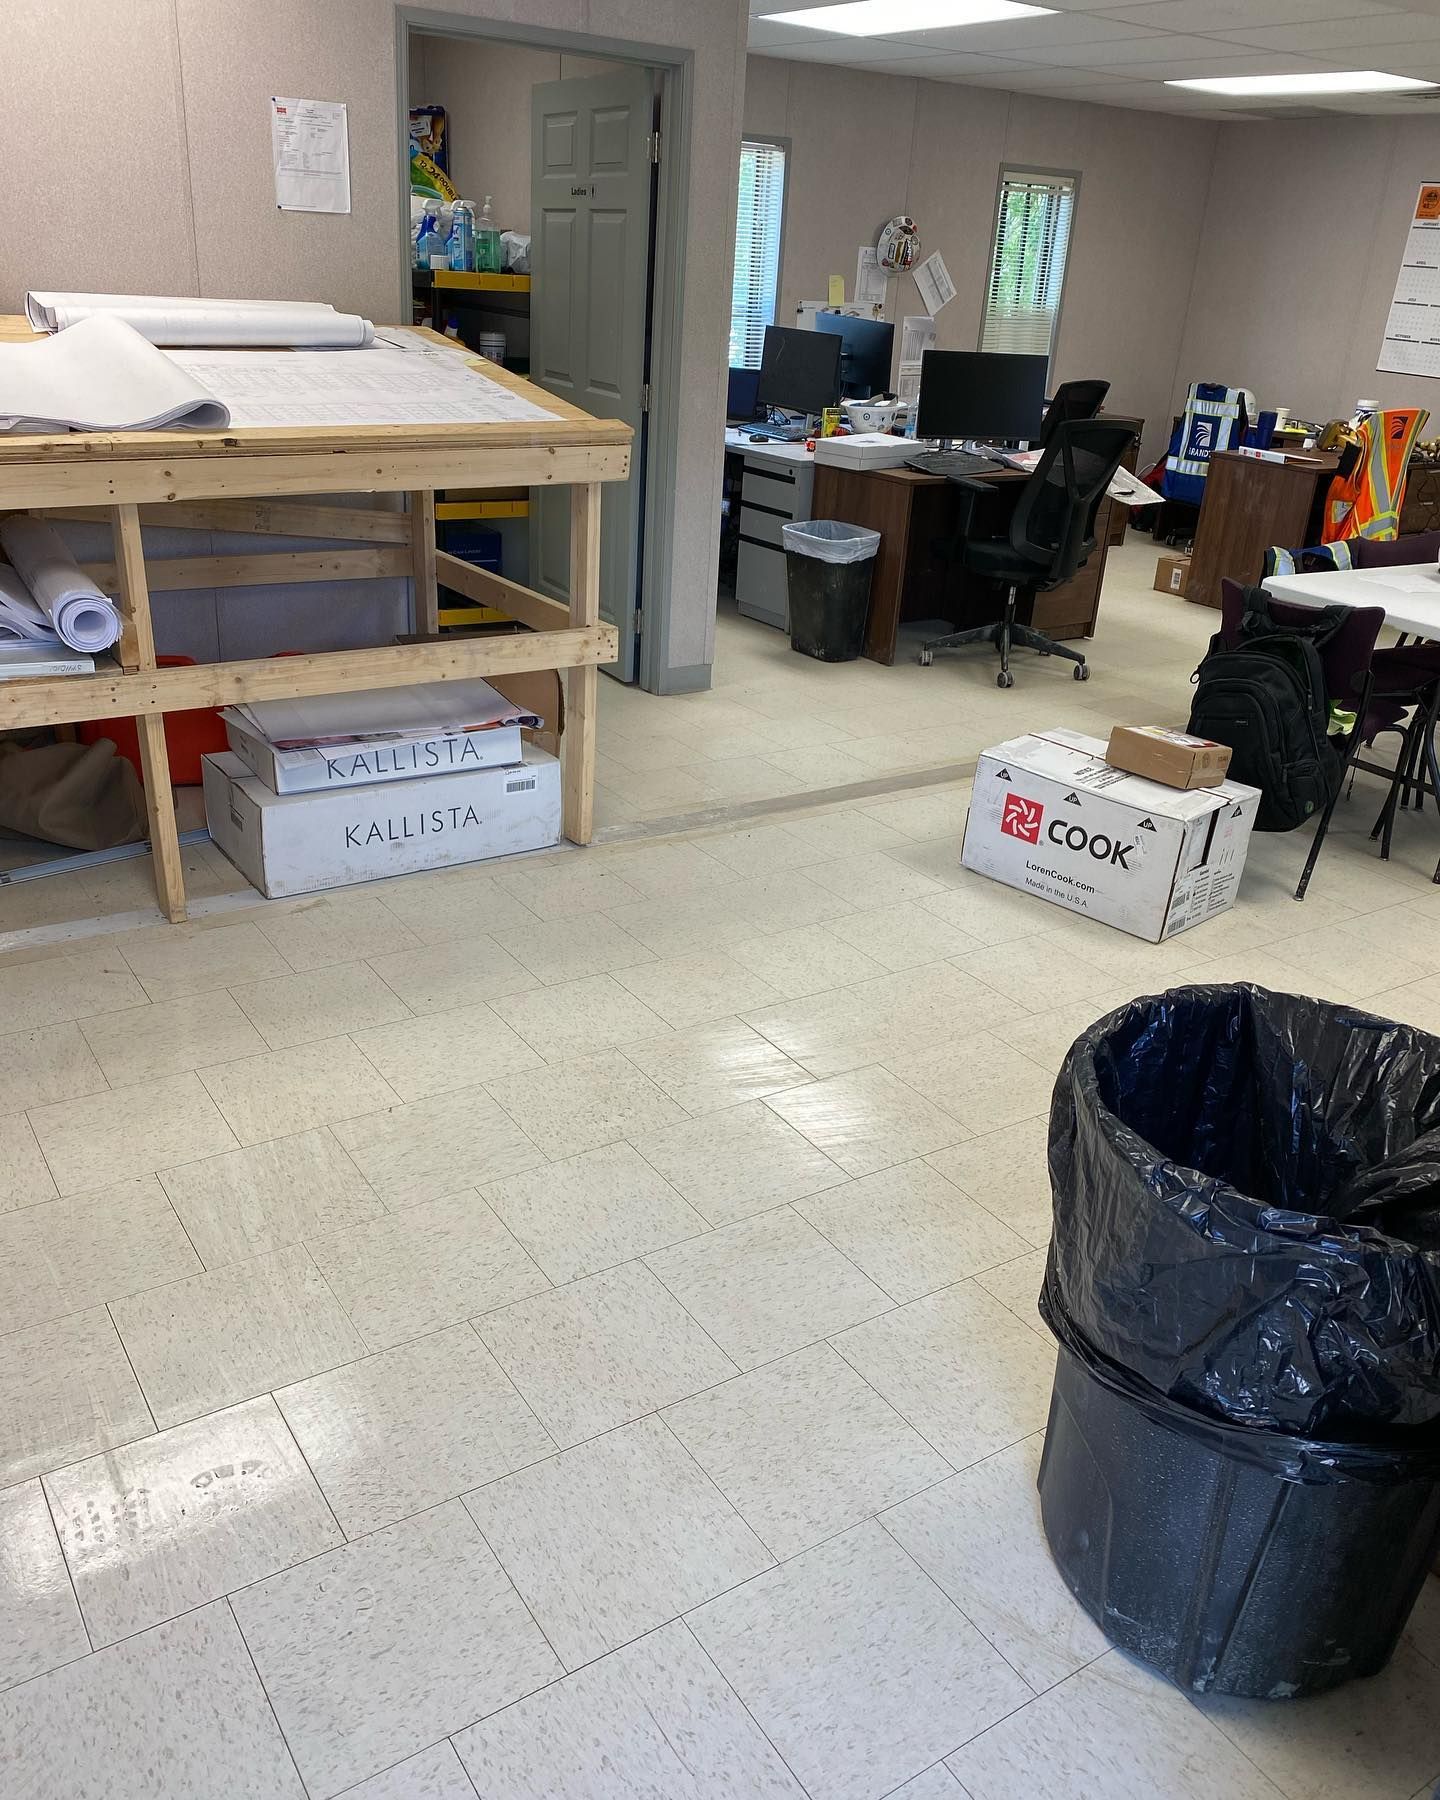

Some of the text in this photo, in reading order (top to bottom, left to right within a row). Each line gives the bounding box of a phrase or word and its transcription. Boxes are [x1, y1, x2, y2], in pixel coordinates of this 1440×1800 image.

[571, 186, 587, 196] Ladies
[327, 736, 480, 779] KALLISTA
[346, 805, 480, 848] KALLISTA
[1048, 819, 1135, 871] COOK
[1025, 860, 1096, 894] LorenCook.com
[1025, 877, 1045, 891] Made
[1046, 885, 1053, 894] in
[1054, 888, 1066, 899] the
